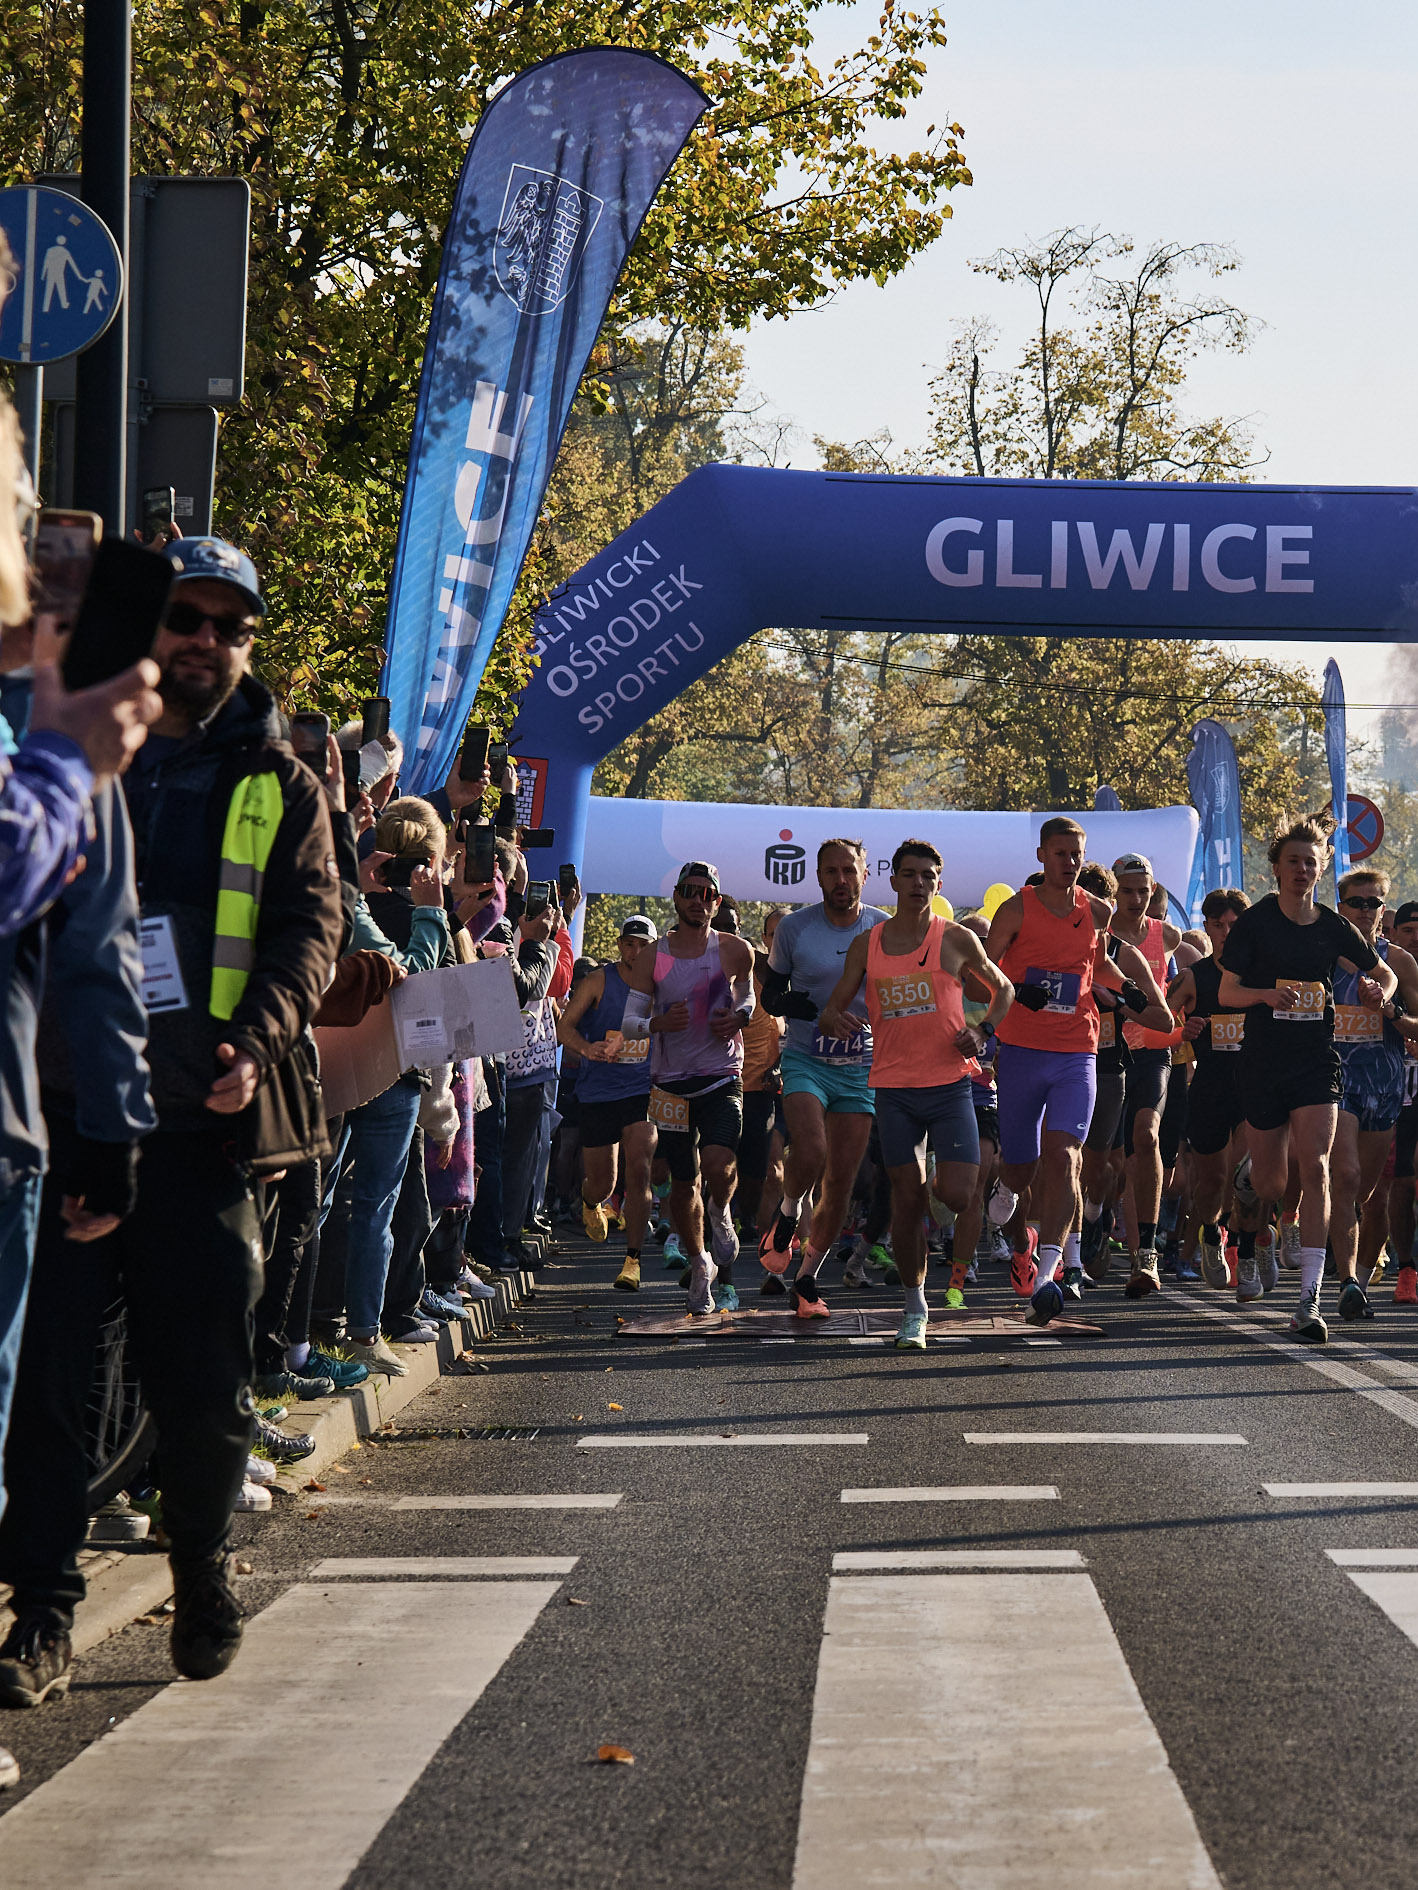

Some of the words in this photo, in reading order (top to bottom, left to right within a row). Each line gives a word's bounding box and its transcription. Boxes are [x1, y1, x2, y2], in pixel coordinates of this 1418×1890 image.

[924, 516, 1315, 593] GLIWICE
[546, 564, 704, 697] OŚRODEK
[578, 621, 705, 734] SPORTU
[880, 981, 930, 1006] 3550
[816, 1034, 863, 1053] 1714
[1335, 1014, 1380, 1031] 3728
